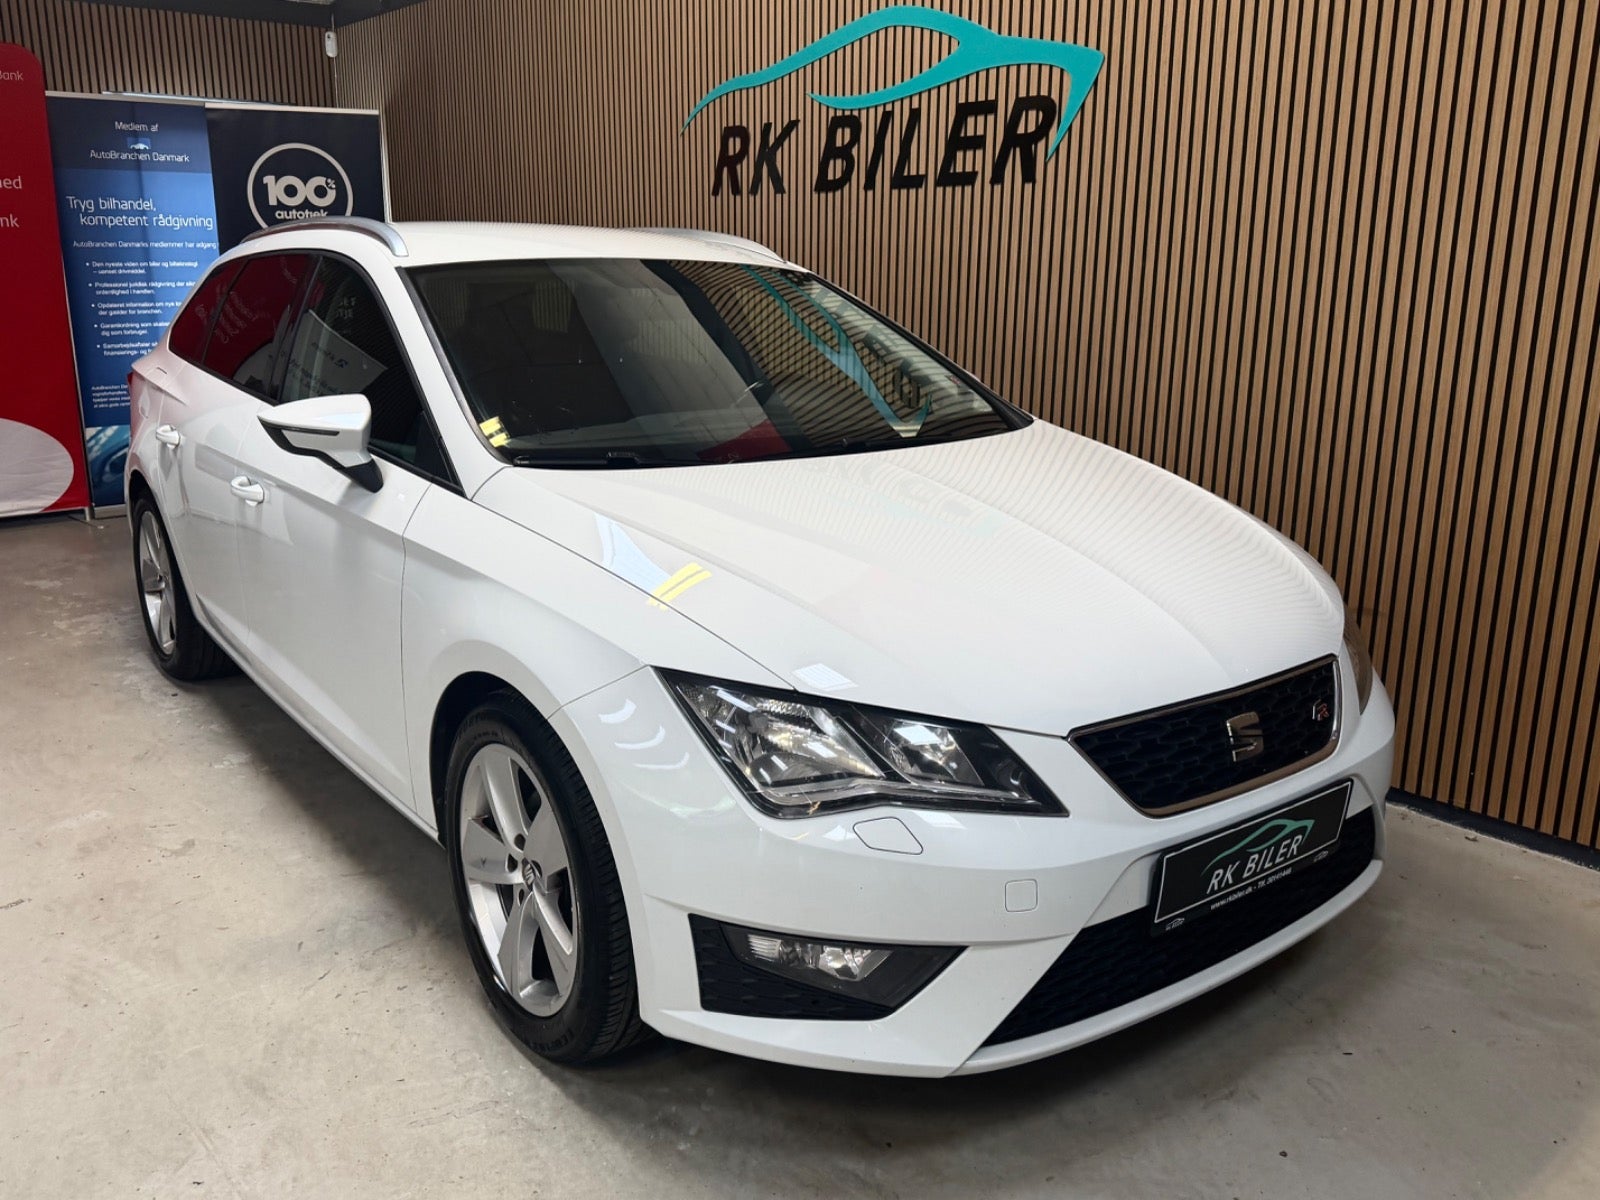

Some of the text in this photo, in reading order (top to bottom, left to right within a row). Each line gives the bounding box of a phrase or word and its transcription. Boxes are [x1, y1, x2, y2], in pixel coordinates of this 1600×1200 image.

[115, 121, 159, 132] Medlem af
[711, 94, 1058, 197] RK BILER
[90, 150, 190, 162] AutoBranchen Danmark
[66, 196, 156, 213] Tryg bilhandel,
[80, 213, 213, 231] kompetent rådgivning
[73, 240, 117, 248] AutoBranchen
[118, 240, 149, 248] Danmarks
[196, 241, 217, 250] adgang
[1206, 834, 1303, 895] RK BILER
